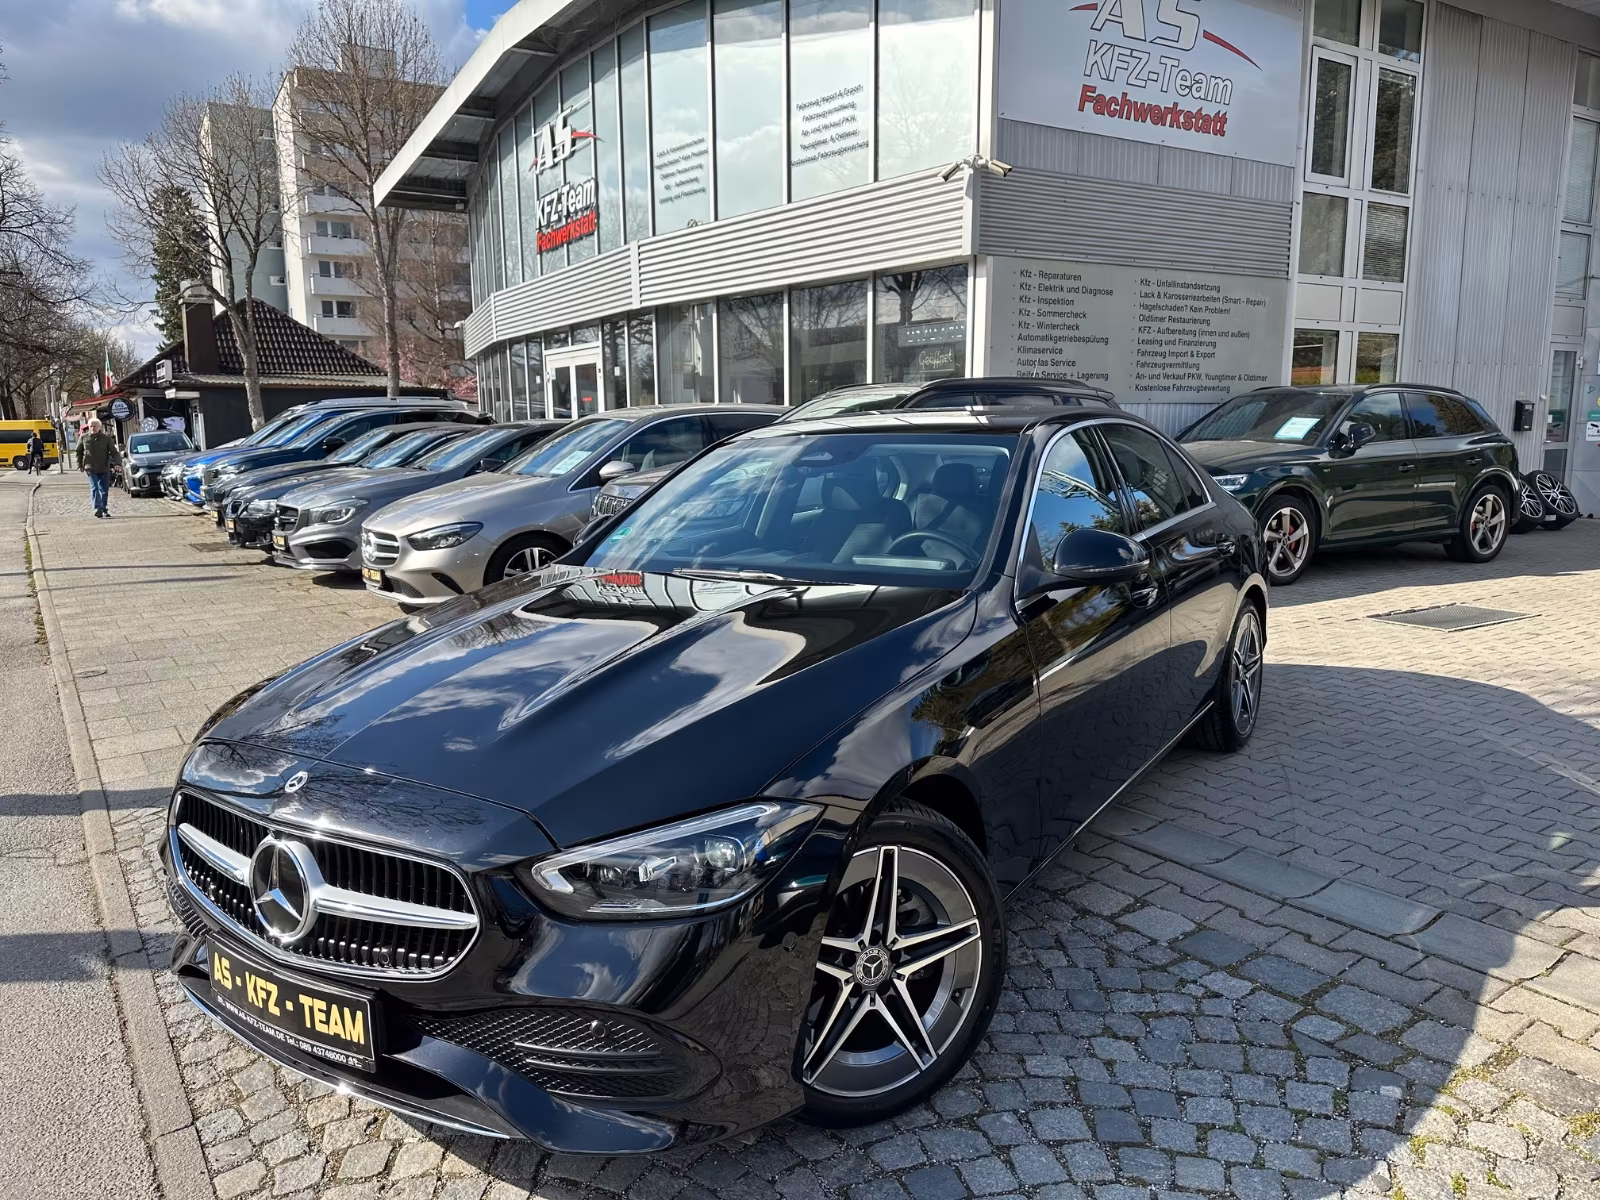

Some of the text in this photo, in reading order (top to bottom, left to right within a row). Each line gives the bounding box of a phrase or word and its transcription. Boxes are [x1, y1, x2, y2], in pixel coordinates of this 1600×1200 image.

[1090, 0, 1200, 51] AS
[1083, 39, 1233, 105] KFZ-Team
[1078, 84, 1228, 137] Fachwerkstatt
[535, 104, 574, 175] AS
[536, 177, 597, 230] KFZ-Team
[536, 210, 598, 255] Fachwerkstatt
[1020, 269, 1032, 278] Kfz
[1039, 270, 1081, 281] Reparaturen
[1020, 282, 1031, 291] Kfz
[1038, 283, 1064, 292] Elektrik
[1082, 286, 1113, 296] Diagnose
[1140, 278, 1151, 286] Kfz
[1156, 279, 1220, 293] Unfallinstandsetzung
[1019, 295, 1031, 303] Kfz
[1038, 296, 1074, 306] Inspektion
[1140, 290, 1155, 298] Lack
[1157, 291, 1161, 299] &
[1163, 292, 1220, 303] Karosseriearbeiten
[1222, 296, 1241, 305] (Smart
[1246, 297, 1266, 307] Repair)
[1019, 308, 1030, 316] Kfz
[1037, 309, 1086, 319] Sommercheck
[1139, 302, 1230, 315] Hagelschaden? Kein Problem!
[1018, 321, 1030, 329] Kfz
[1037, 321, 1080, 331] Wintercheck
[1139, 314, 1211, 326] Oldtimer Restaurierung
[1017, 333, 1109, 345] Automatikgetriebespülung
[1138, 326, 1151, 334] KFZ
[1157, 327, 1196, 337] Aufbereitung
[1198, 328, 1217, 338] (innen
[1231, 331, 1250, 340] außen)
[1137, 337, 1216, 349] Leasing und Finanzierung
[1017, 346, 1063, 355] Klimaservice
[1137, 349, 1166, 359] Fahrzeug
[1168, 349, 1189, 359] Import
[1196, 351, 1215, 360] Export
[1017, 358, 1076, 369] Autoglas Service
[1136, 360, 1200, 370] Fahrzeugvermittlung
[1042, 371, 1067, 379] Service
[1077, 371, 1109, 381] Lagerung
[1136, 372, 1147, 380] An-
[1204, 374, 1236, 382] Youngtimer
[1243, 374, 1267, 382] Oldtimer
[1135, 384, 1230, 393] Kostenlose Fahrzeugbewertung
[213, 951, 233, 990] AS
[245, 970, 281, 1017] KFZ
[298, 993, 365, 1045] TEAM
[285, 1035, 299, 1047] Tel.:
[299, 1041, 312, 1052] 089
